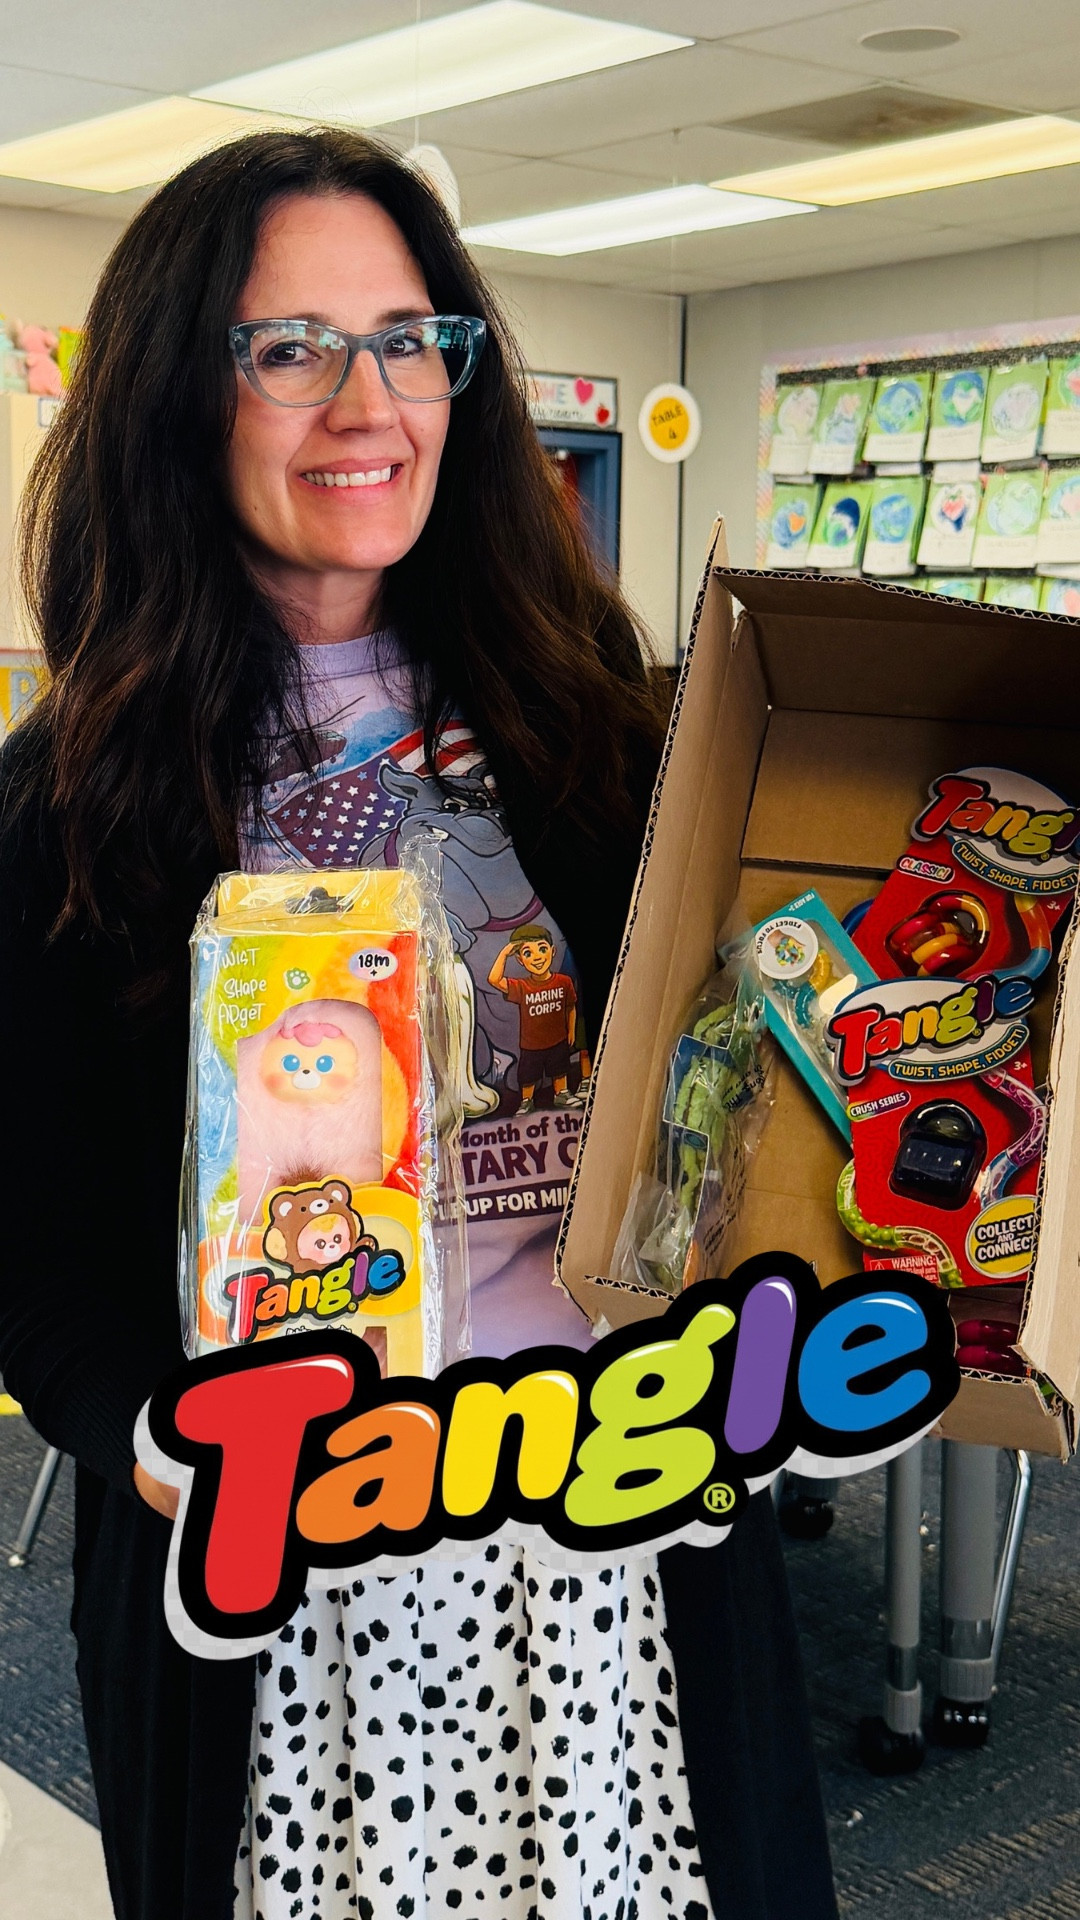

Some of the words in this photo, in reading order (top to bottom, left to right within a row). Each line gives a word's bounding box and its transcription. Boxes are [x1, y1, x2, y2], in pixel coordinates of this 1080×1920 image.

[921, 778, 1080, 855] Tangl
[900, 857, 952, 880] CLASSIC!
[957, 844, 988, 875] TWIST,
[988, 868, 1028, 891] SHAPE,
[775, 920, 802, 930] FIDGET
[525, 987, 564, 1005] MARINE
[529, 1001, 562, 1017] CORPS
[895, 1063, 934, 1079] TWIST,
[938, 1059, 986, 1077] SHAPE,
[985, 1028, 1025, 1064] FIDGET!
[1013, 1061, 1028, 1071] 3+
[850, 1101, 878, 1117] CRUSH
[878, 1092, 906, 1108] SERIES
[526, 1116, 549, 1139] of
[461, 1141, 549, 1186] TARY
[465, 1197, 492, 1217] UP
[496, 1191, 538, 1213] FOR
[977, 1214, 1034, 1240] COLLECT
[997, 1233, 1014, 1243] AND
[891, 1255, 936, 1269] WARNING:
